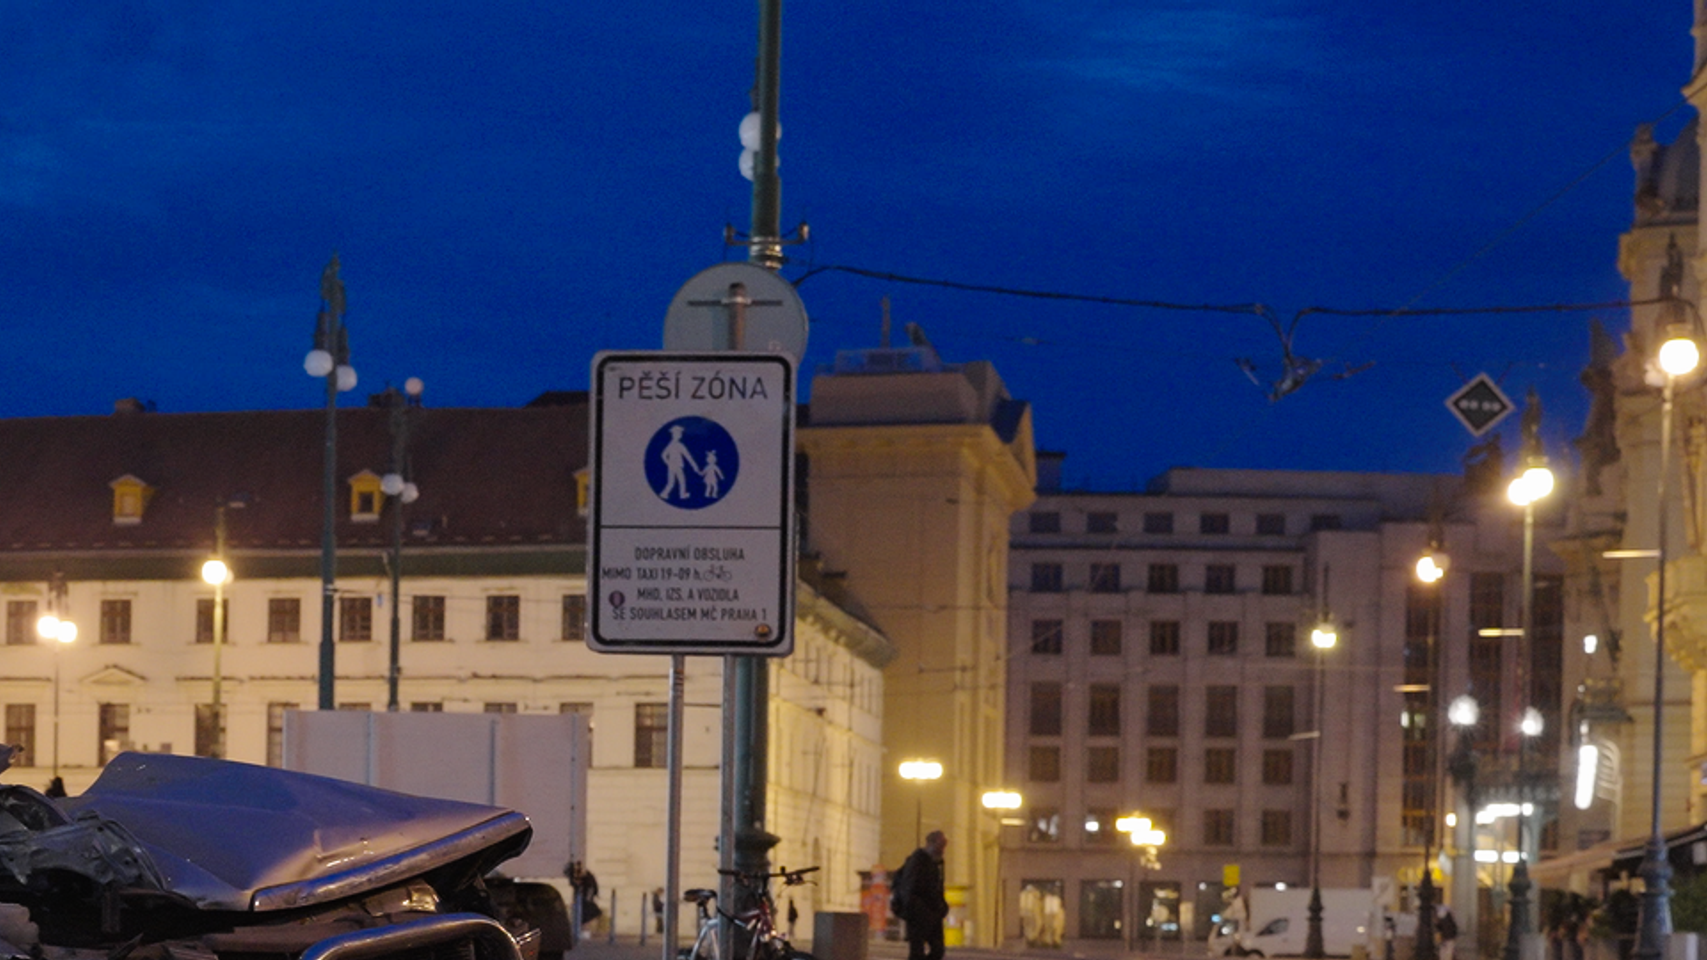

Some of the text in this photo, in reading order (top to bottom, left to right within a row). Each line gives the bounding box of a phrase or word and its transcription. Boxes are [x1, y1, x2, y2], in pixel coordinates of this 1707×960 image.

[618, 370, 768, 400] PĚŠÍ ZÓNA
[634, 546, 745, 561] DOPRAVNÍ OBSLUHA
[637, 567, 659, 581] TAXI
[661, 567, 692, 581] 19-09
[688, 588, 695, 600] A
[697, 588, 740, 601] VOZIDLA
[612, 603, 768, 621] SE SOUHLASEM MČ PRAHA 1
